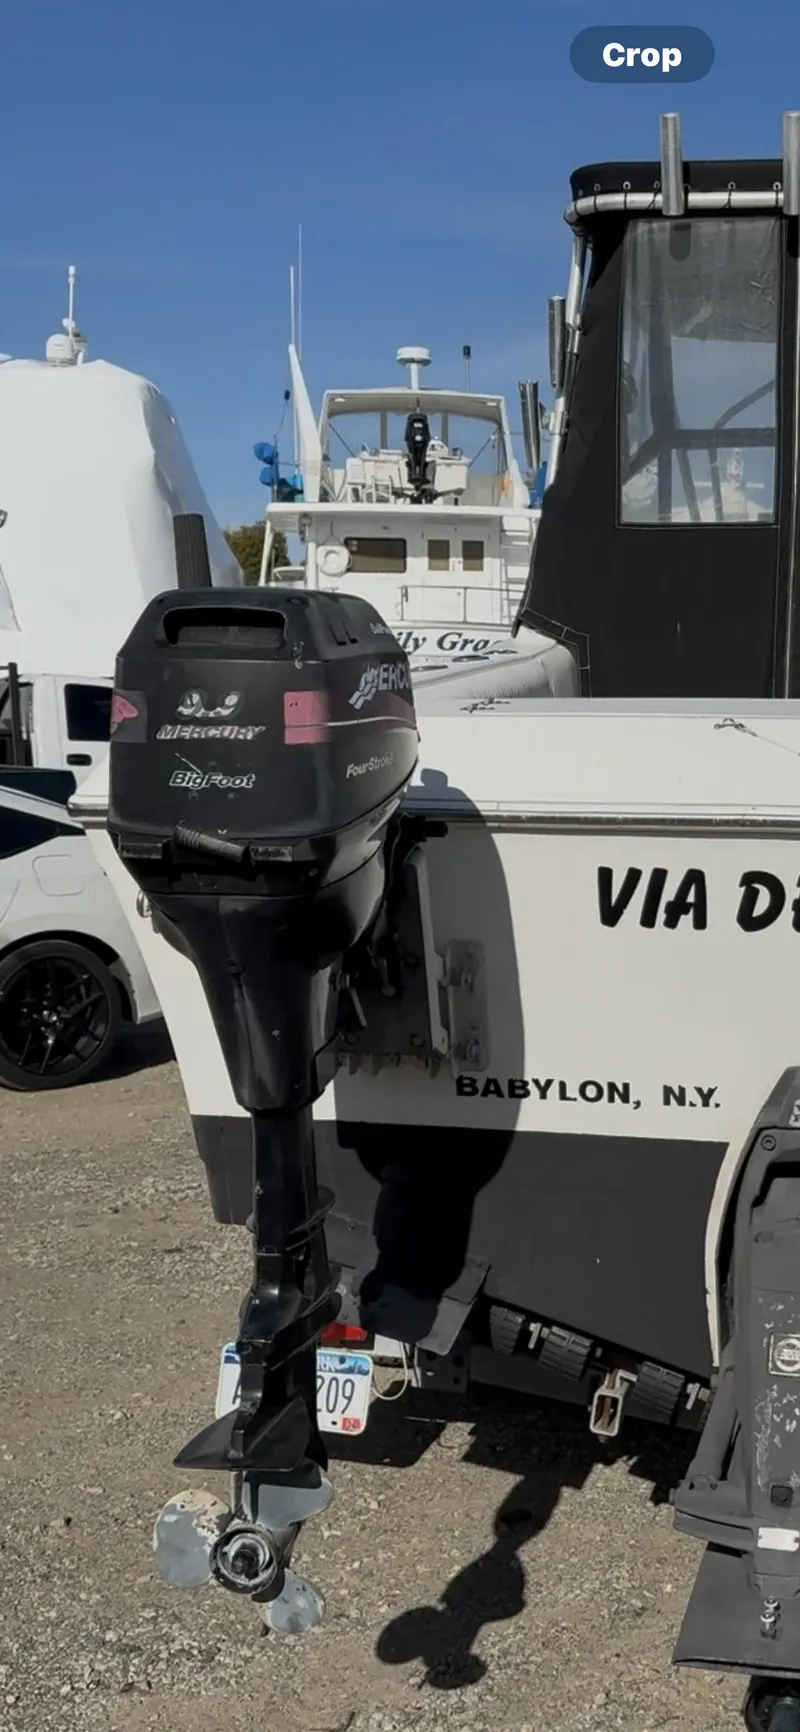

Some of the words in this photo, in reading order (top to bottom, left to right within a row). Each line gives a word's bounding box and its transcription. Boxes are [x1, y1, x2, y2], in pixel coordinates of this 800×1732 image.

[156, 723, 266, 740] MERCURY
[168, 770, 257, 791] BigFoot
[597, 866, 708, 931] VIA
[455, 1075, 642, 1110] BABYLON,
[662, 1084, 721, 1108] N.Y.
